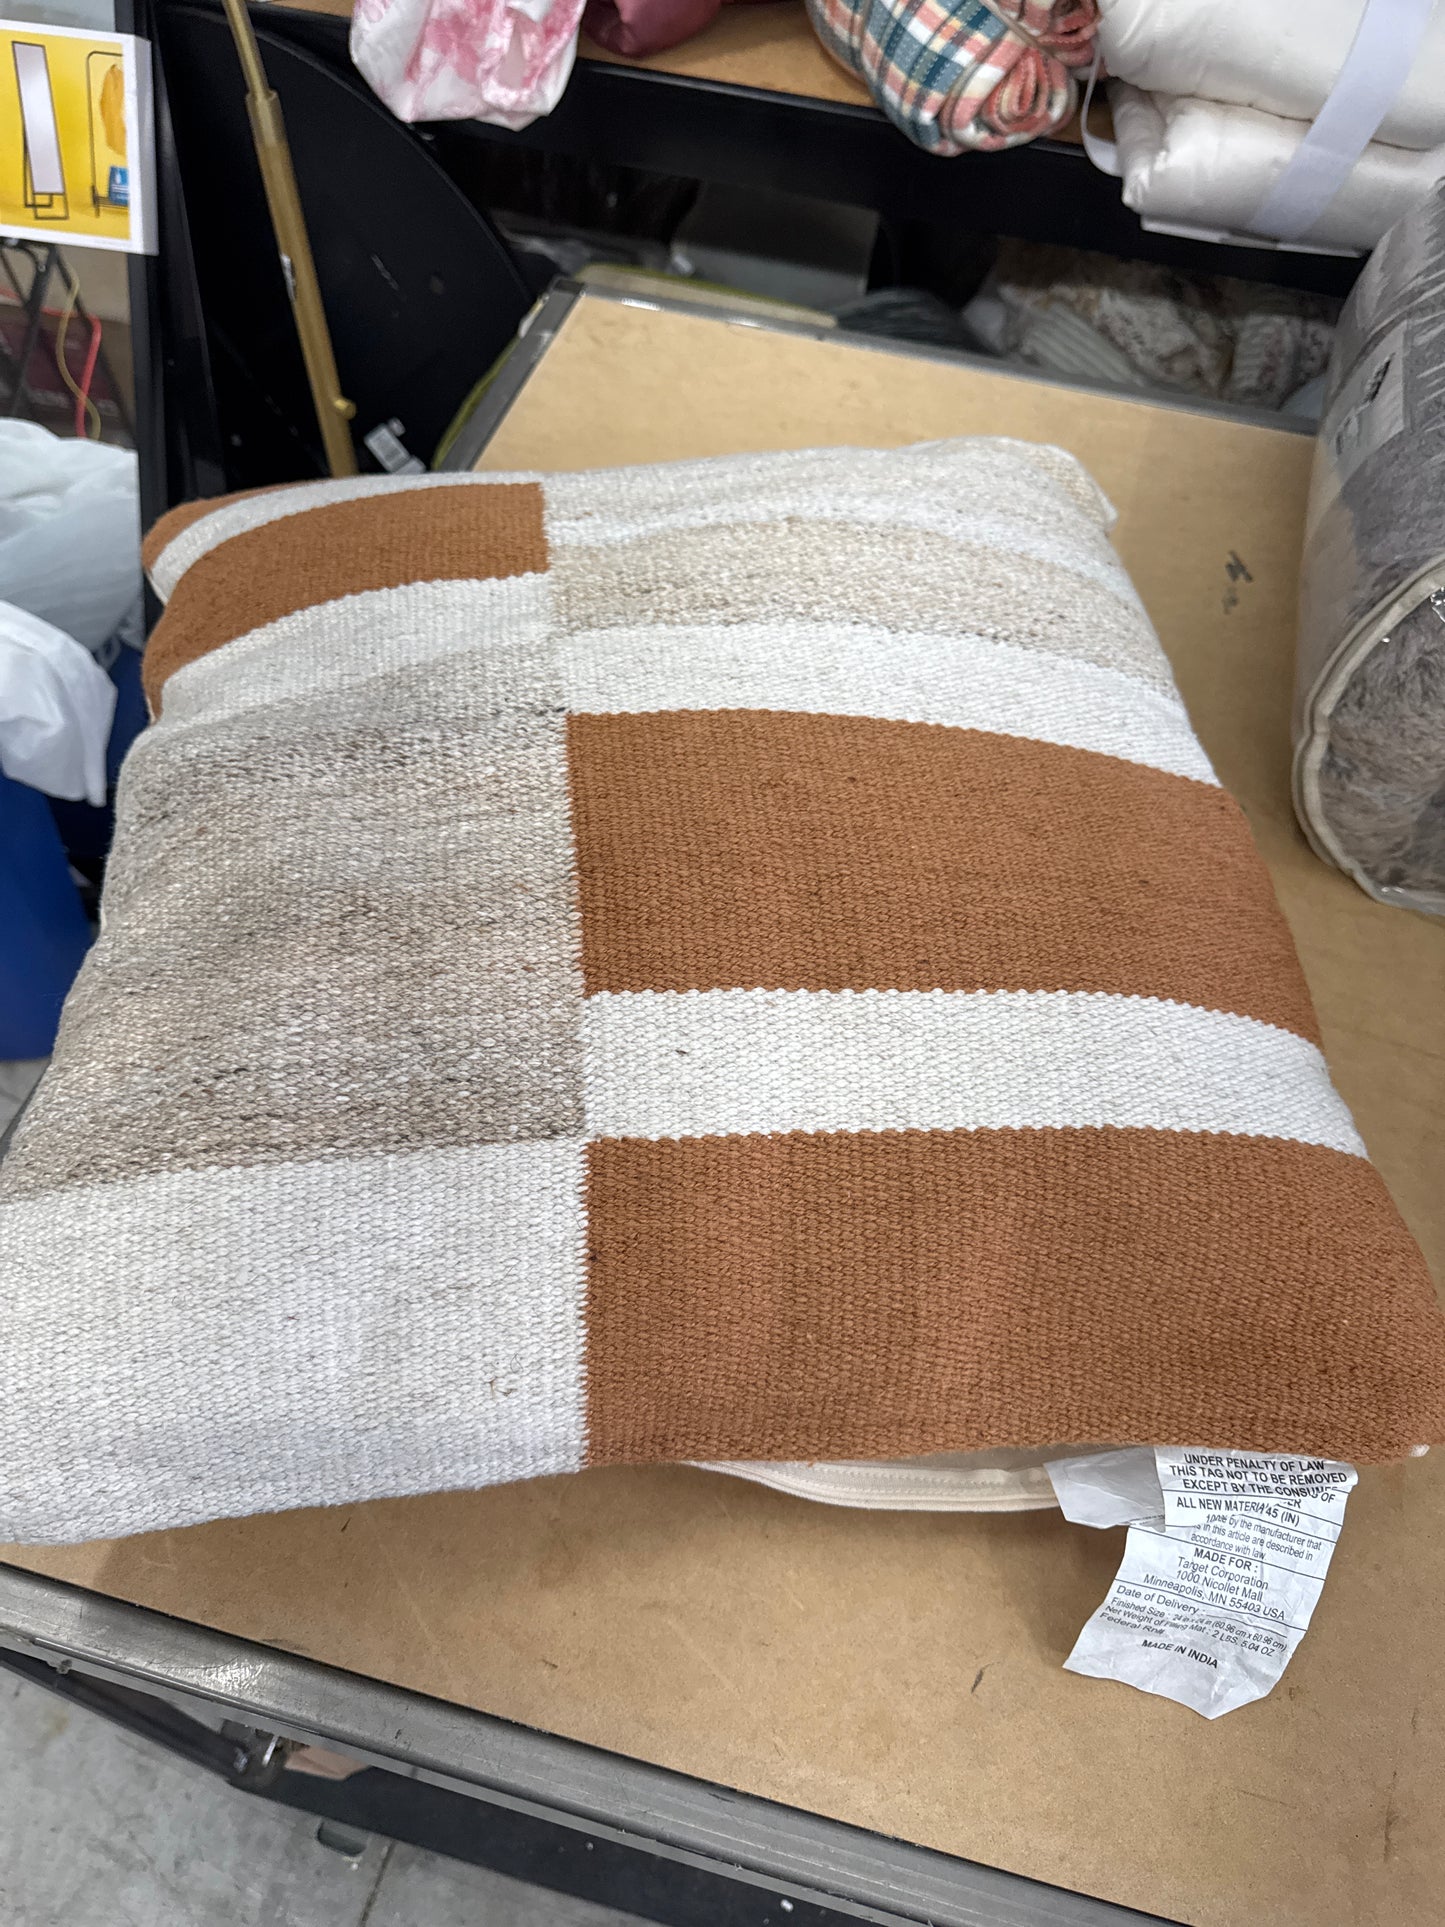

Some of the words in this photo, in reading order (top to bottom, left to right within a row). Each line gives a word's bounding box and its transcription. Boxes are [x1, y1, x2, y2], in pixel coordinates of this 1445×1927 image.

[1169, 1465, 1197, 1476] THIS
[1199, 1467, 1224, 1478] TAG
[1225, 1469, 1249, 1480] NOT
[1251, 1472, 1268, 1482] TO
[1270, 1473, 1286, 1485] BE
[1288, 1472, 1347, 1485] REMOVED
[1184, 1453, 1225, 1467] UNDER
[1226, 1457, 1276, 1471] PENALTY
[1280, 1461, 1295, 1472] OF
[1299, 1461, 1324, 1472] LAW
[1182, 1479, 1228, 1492] EXCEPT
[1231, 1482, 1246, 1493] BY
[1249, 1484, 1273, 1494] THE
[1177, 1496, 1196, 1509] ALL
[1198, 1498, 1222, 1510] NEW
[1281, 1511, 1300, 1527] (IN)
[1191, 1533, 1233, 1551] accordance
[1235, 1545, 1251, 1555] with
[1203, 1523, 1211, 1532] in
[1212, 1525, 1226, 1537] this
[1228, 1530, 1250, 1543] article
[1251, 1536, 1265, 1547] are
[1266, 1540, 1305, 1558] described
[1305, 1551, 1313, 1561] in
[1240, 1519, 1252, 1530] the
[1253, 1524, 1305, 1546] manufacturer
[1307, 1539, 1322, 1550] that
[1178, 1556, 1209, 1573] Target
[1211, 1565, 1269, 1590] Corporation
[1194, 1547, 1227, 1564] MADE
[1228, 1557, 1252, 1571] FOR
[1116, 1585, 1141, 1599] Date
[1144, 1593, 1156, 1601] of
[1157, 1595, 1200, 1615] Delivery
[1144, 1574, 1205, 1600] Minneapolis,
[1208, 1591, 1227, 1605] MN
[1229, 1597, 1261, 1613] 55403
[1263, 1606, 1285, 1620] USA
[1176, 1570, 1200, 1584] 1000
[1202, 1576, 1240, 1595] Nicollet
[1241, 1587, 1264, 1602] Mall
[1100, 1612, 1142, 1629] Federal
[1105, 1605, 1122, 1615] Net
[1123, 1610, 1153, 1624] Weight
[1153, 1618, 1165, 1626] of
[1212, 1629, 1220, 1638] 2
[1241, 1640, 1259, 1652] 5.04
[1260, 1646, 1275, 1657] OZ
[1111, 1597, 1146, 1613] Finished
[1146, 1606, 1166, 1618] Size
[1211, 1621, 1236, 1634] (60.96
[1236, 1629, 1247, 1638] cm
[1252, 1633, 1273, 1645] 60.96
[1272, 1641, 1288, 1653] cm)
[1141, 1640, 1174, 1651] MADE
[1174, 1645, 1187, 1654] IN
[1187, 1649, 1218, 1669] INDIA
